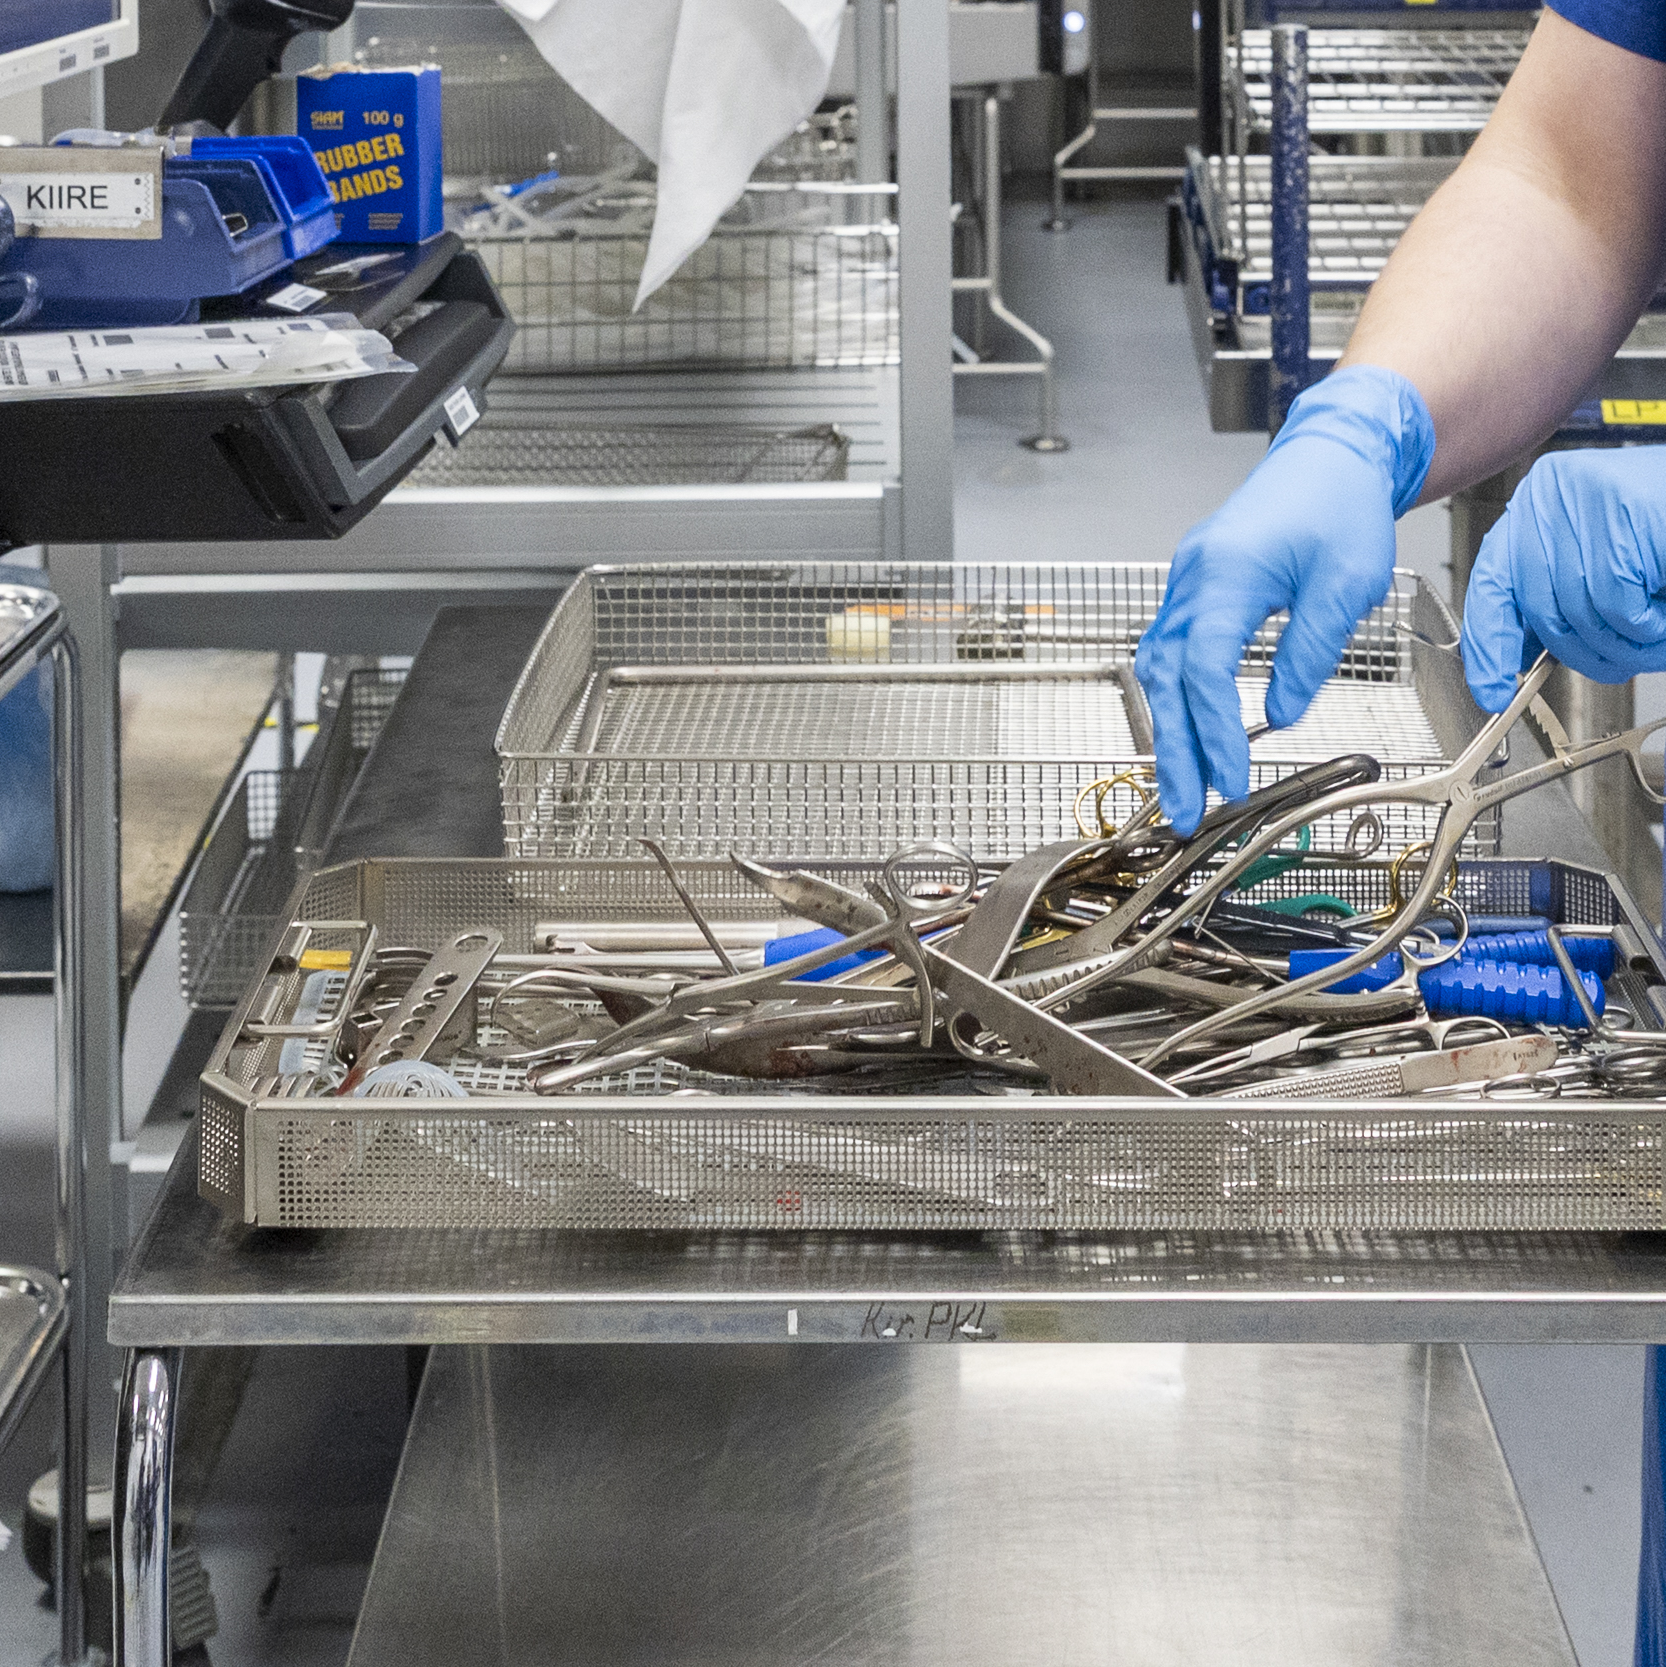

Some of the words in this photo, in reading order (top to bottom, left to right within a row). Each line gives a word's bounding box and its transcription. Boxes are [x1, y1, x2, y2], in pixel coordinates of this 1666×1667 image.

[362, 111, 389, 125] 100
[393, 113, 404, 128] g
[314, 132, 405, 174] RUBBER
[27, 185, 109, 210] KIIRE
